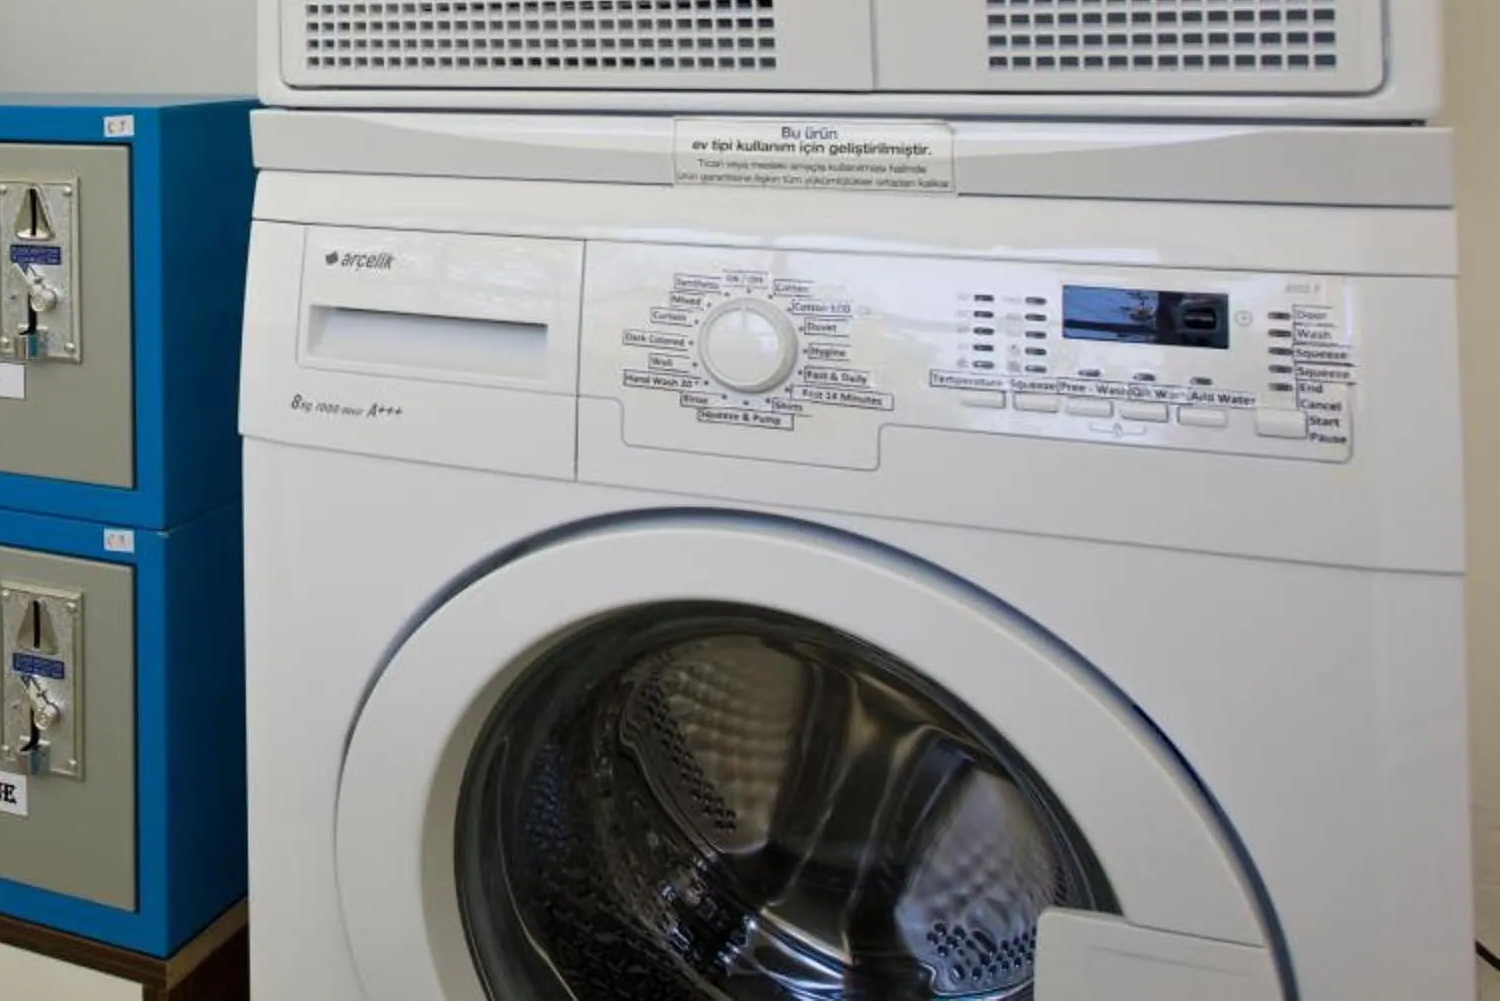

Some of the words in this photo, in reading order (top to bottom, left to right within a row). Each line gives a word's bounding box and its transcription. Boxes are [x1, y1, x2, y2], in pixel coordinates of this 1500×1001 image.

[781, 126, 801, 140] Bu
[805, 126, 838, 140] ürün
[692, 140, 708, 150] ev
[712, 138, 733, 153] tipi
[736, 140, 796, 152] kullanım
[799, 141, 825, 155] için
[341, 252, 395, 272] arçelik
[1297, 310, 1328, 320] Door
[1297, 329, 1332, 340] Wash
[624, 374, 650, 385] Hand
[653, 377, 678, 387] Wash
[1300, 382, 1323, 394] End
[1217, 393, 1256, 405] Water
[1301, 399, 1342, 411] Cancel
[366, 403, 403, 417] A+++
[1309, 414, 1340, 428] Start
[1311, 432, 1347, 445] Pause
